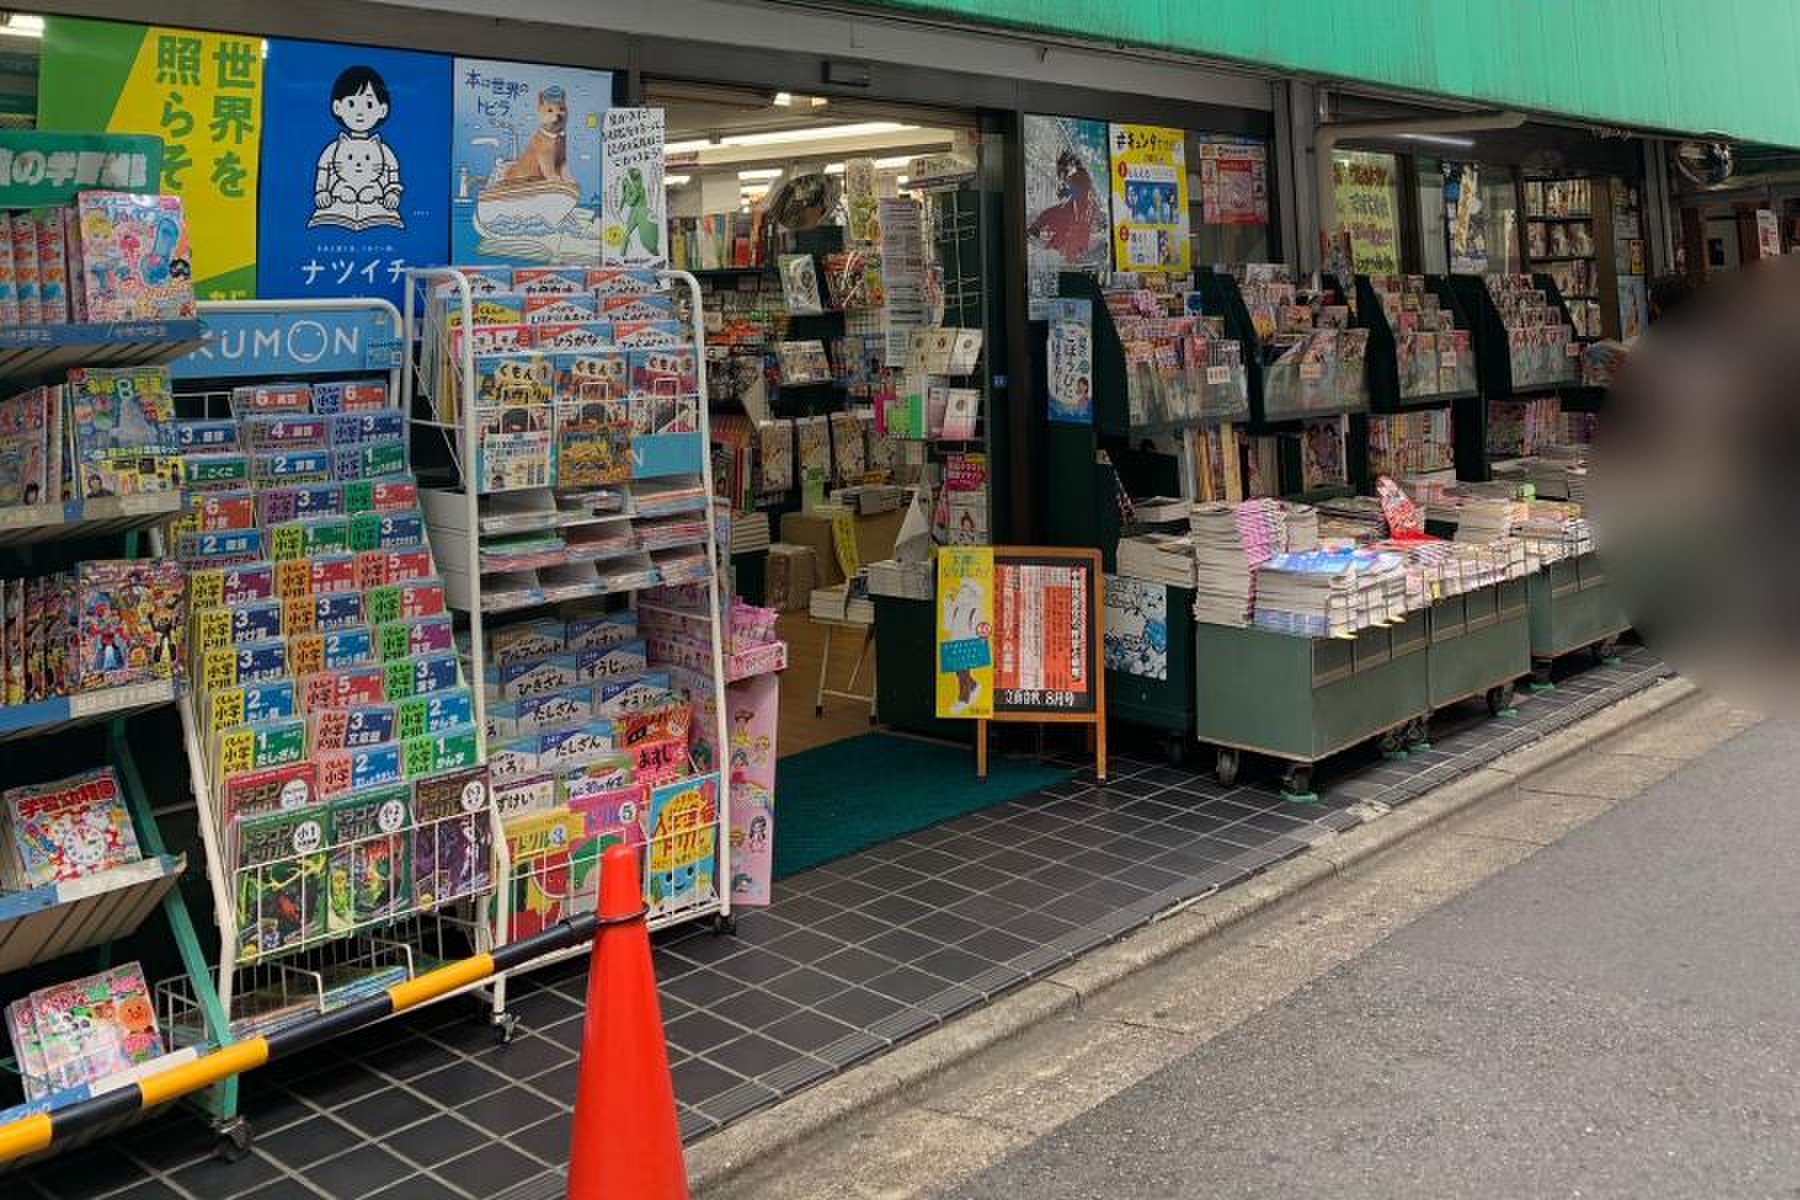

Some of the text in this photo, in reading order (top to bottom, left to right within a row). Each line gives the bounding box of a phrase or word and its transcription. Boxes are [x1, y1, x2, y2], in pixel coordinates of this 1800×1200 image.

[210, 40, 257, 199] 世界を
[301, 259, 414, 285] ナツイチ
